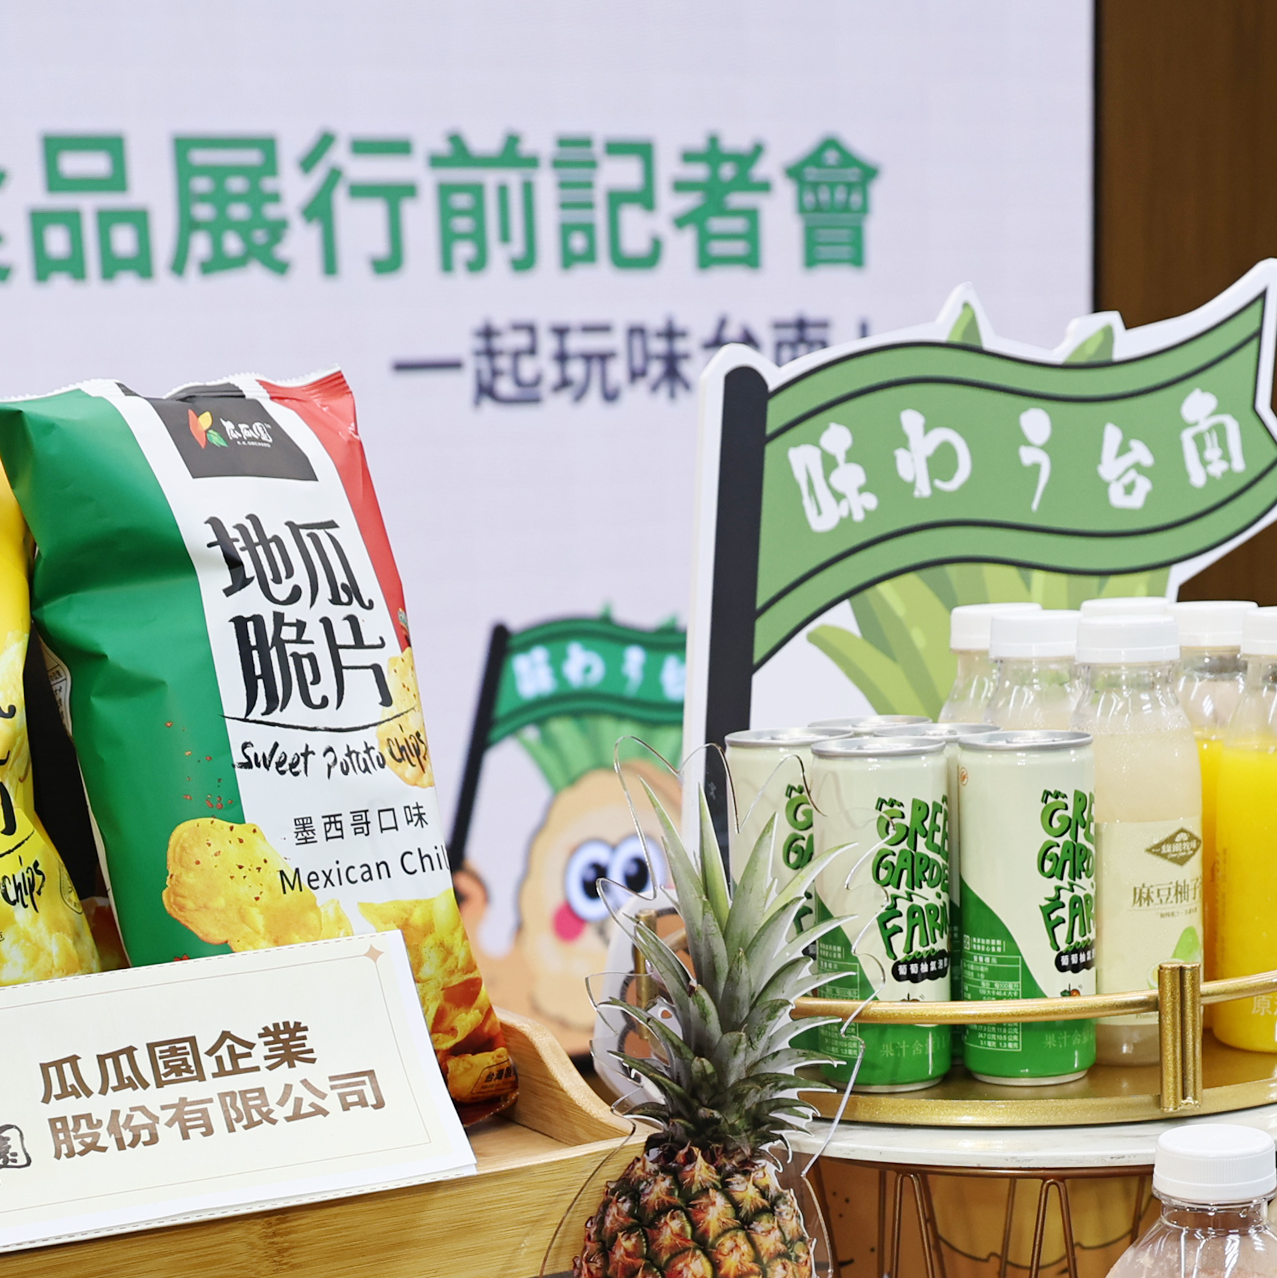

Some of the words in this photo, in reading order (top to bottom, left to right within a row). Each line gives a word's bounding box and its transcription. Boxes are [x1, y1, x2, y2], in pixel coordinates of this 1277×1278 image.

[204, 512, 374, 609] 地瓜
[228, 611, 393, 720] 脆片
[293, 802, 429, 846] 墨西哥口味
[278, 859, 392, 895] Mexican
[1131, 877, 1202, 908] 麻豆柚子
[39, 1021, 319, 1106] 瓜瓜園企業
[47, 1069, 388, 1161] 股份有限公司
